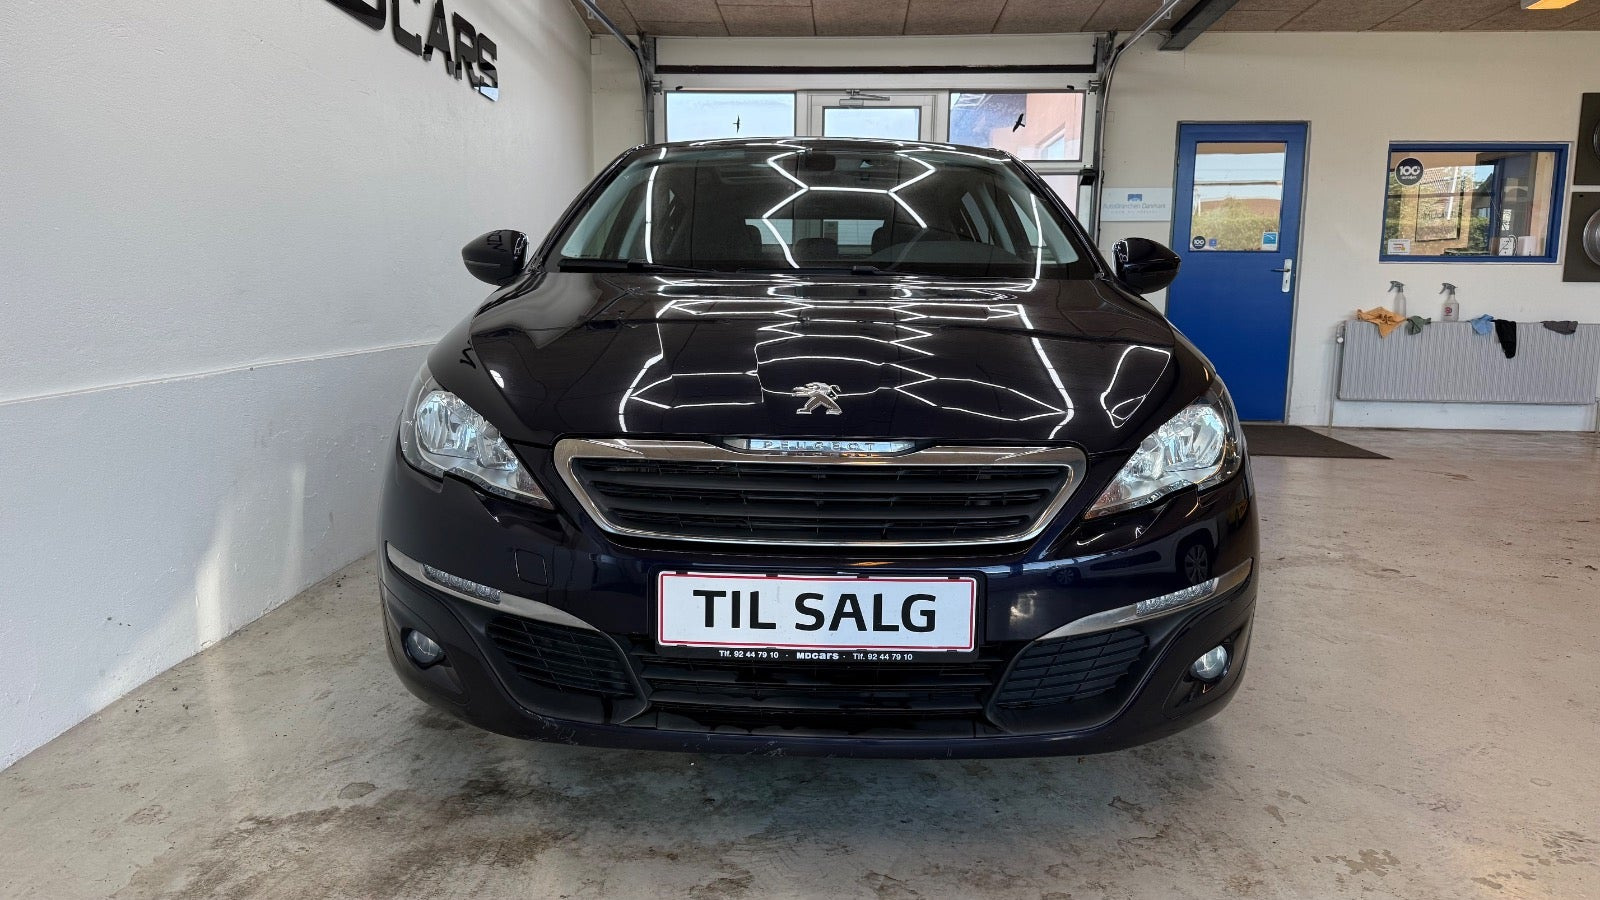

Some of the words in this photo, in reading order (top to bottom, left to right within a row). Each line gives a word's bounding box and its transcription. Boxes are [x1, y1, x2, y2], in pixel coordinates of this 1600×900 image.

[763, 441, 875, 451] PEUGEOT
[692, 589, 777, 630] TIL
[794, 592, 937, 633] SALG
[733, 650, 744, 658] 92
